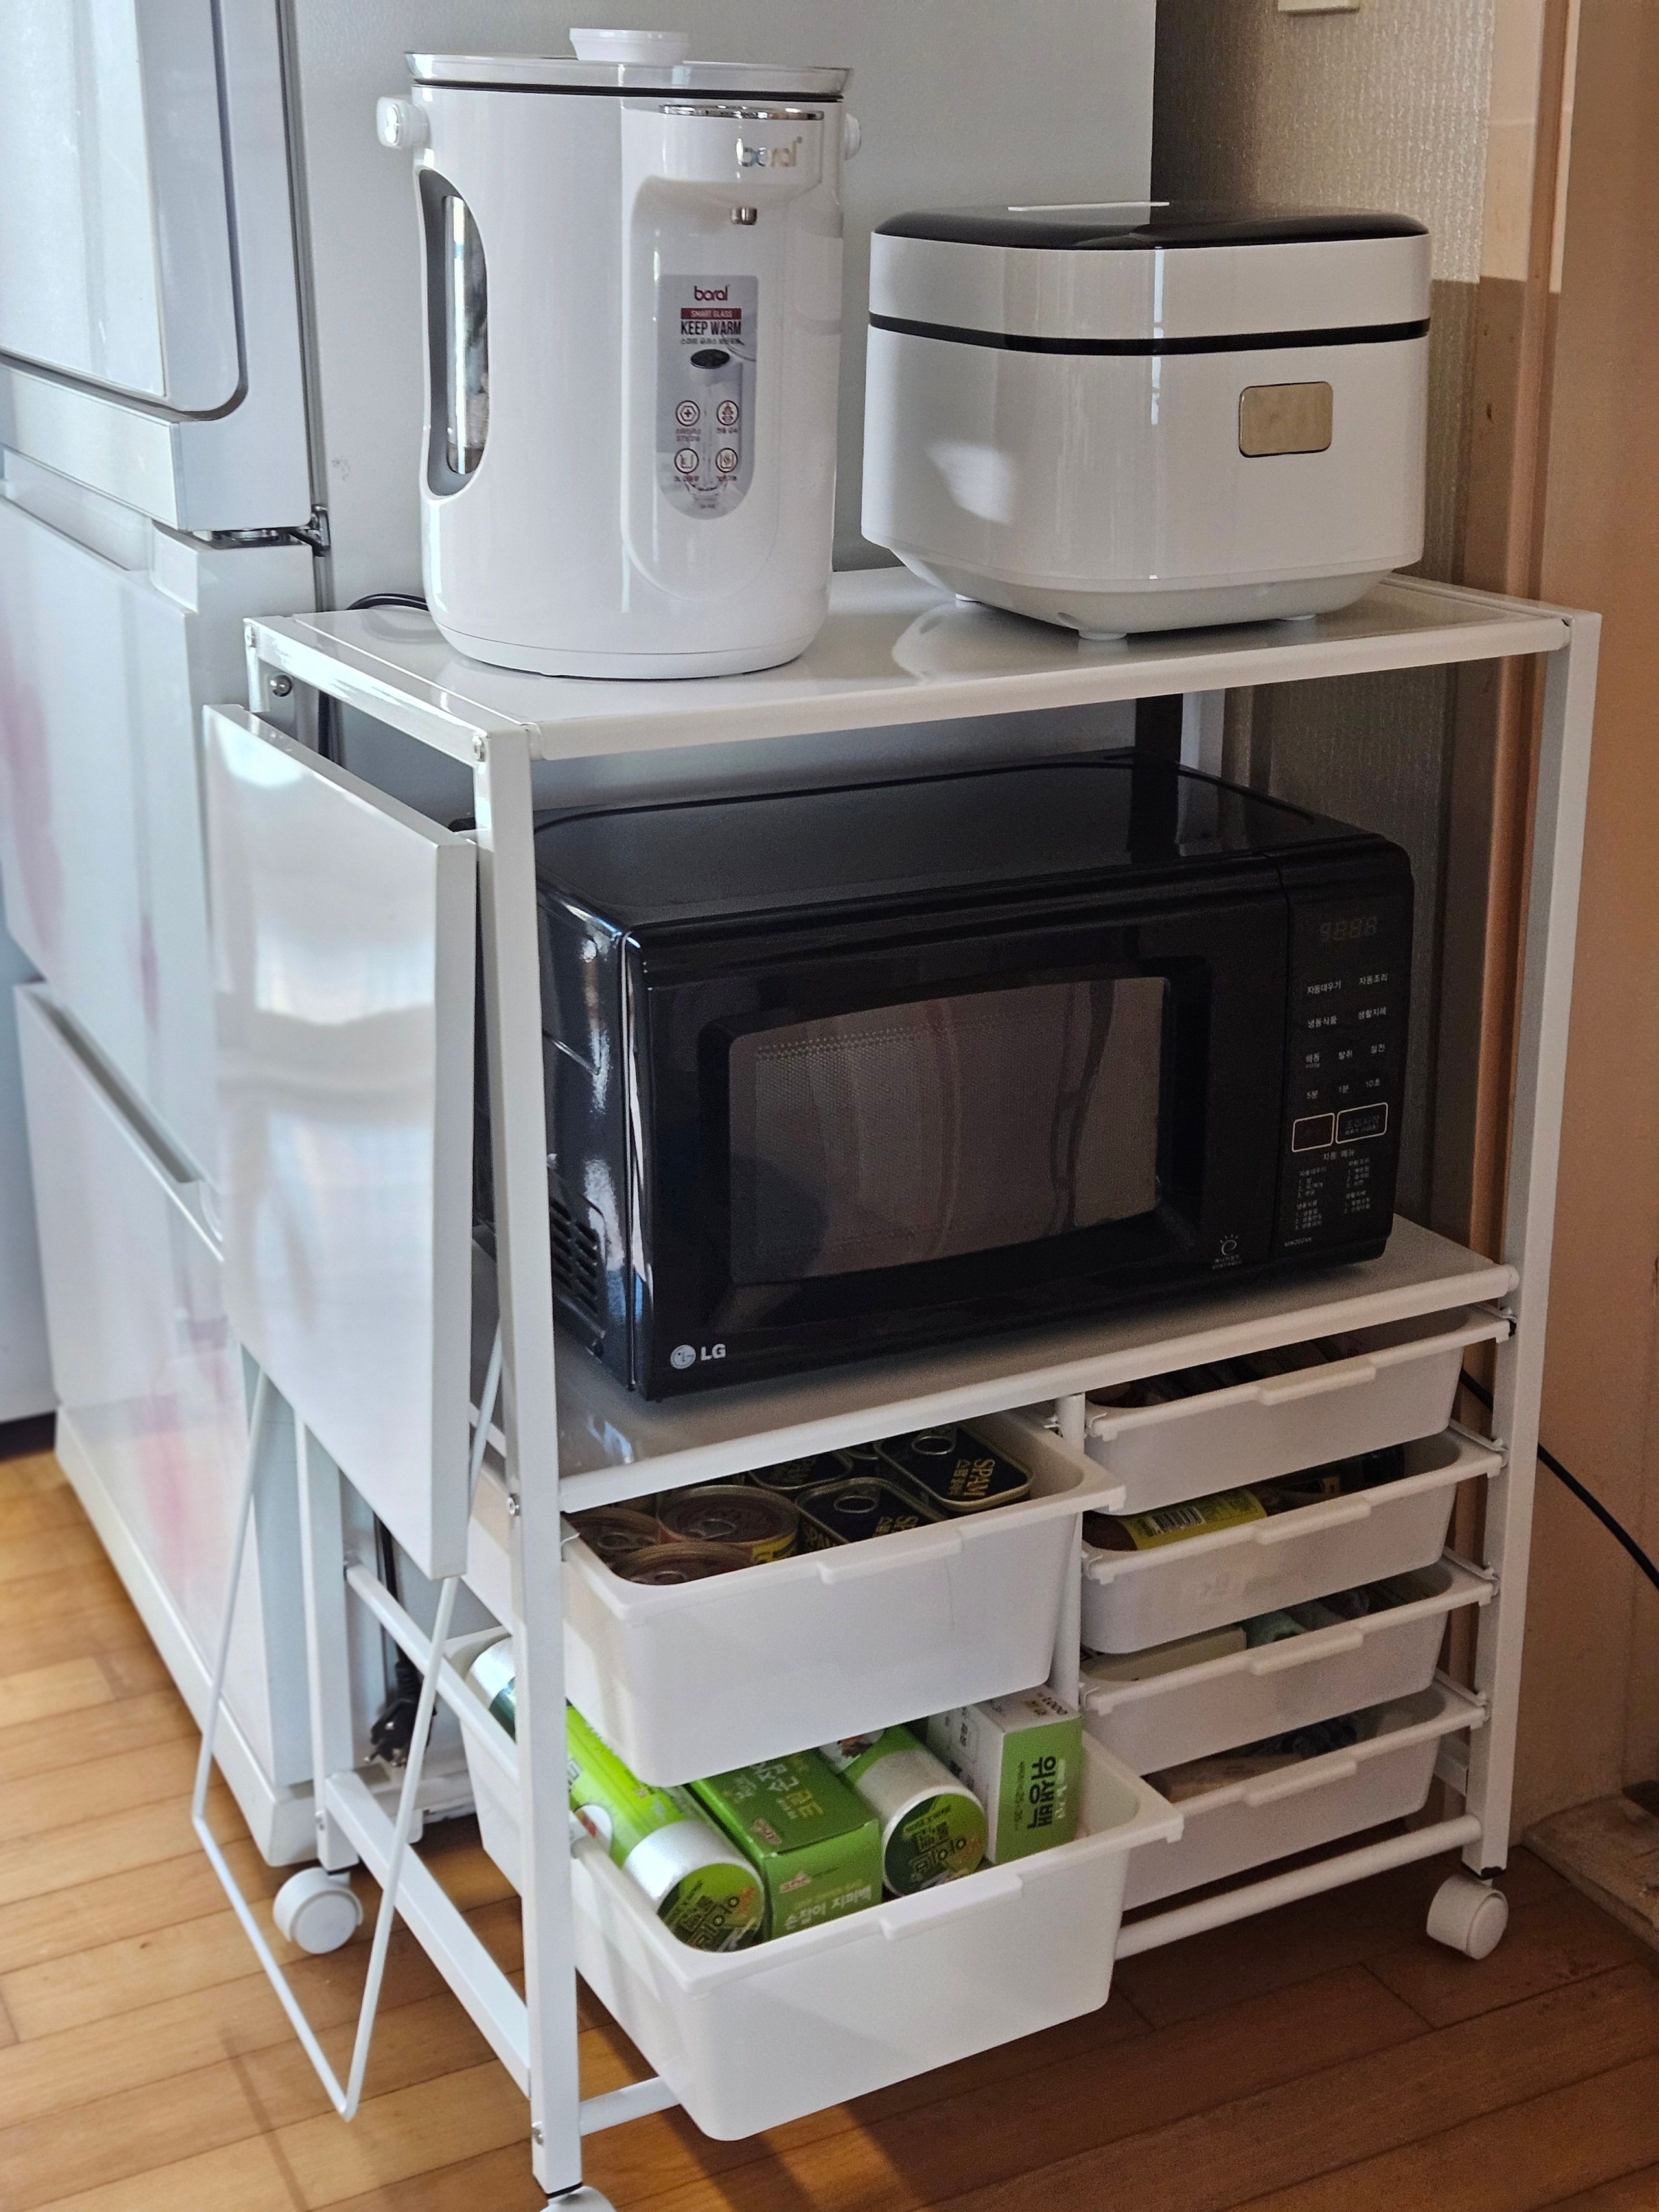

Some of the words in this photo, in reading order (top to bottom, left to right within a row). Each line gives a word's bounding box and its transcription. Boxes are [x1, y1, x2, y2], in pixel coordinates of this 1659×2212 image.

[694, 286, 728, 301] boral
[680, 321, 708, 336] KEEP
[710, 321, 741, 336] WARM
[1306, 980, 1341, 994] 자동데우기
[1359, 973, 1388, 985] 자동조리
[1365, 1078, 1380, 1088] 10초
[701, 1344, 726, 1361] LG
[1027, 1755, 1057, 1830] 위생백
